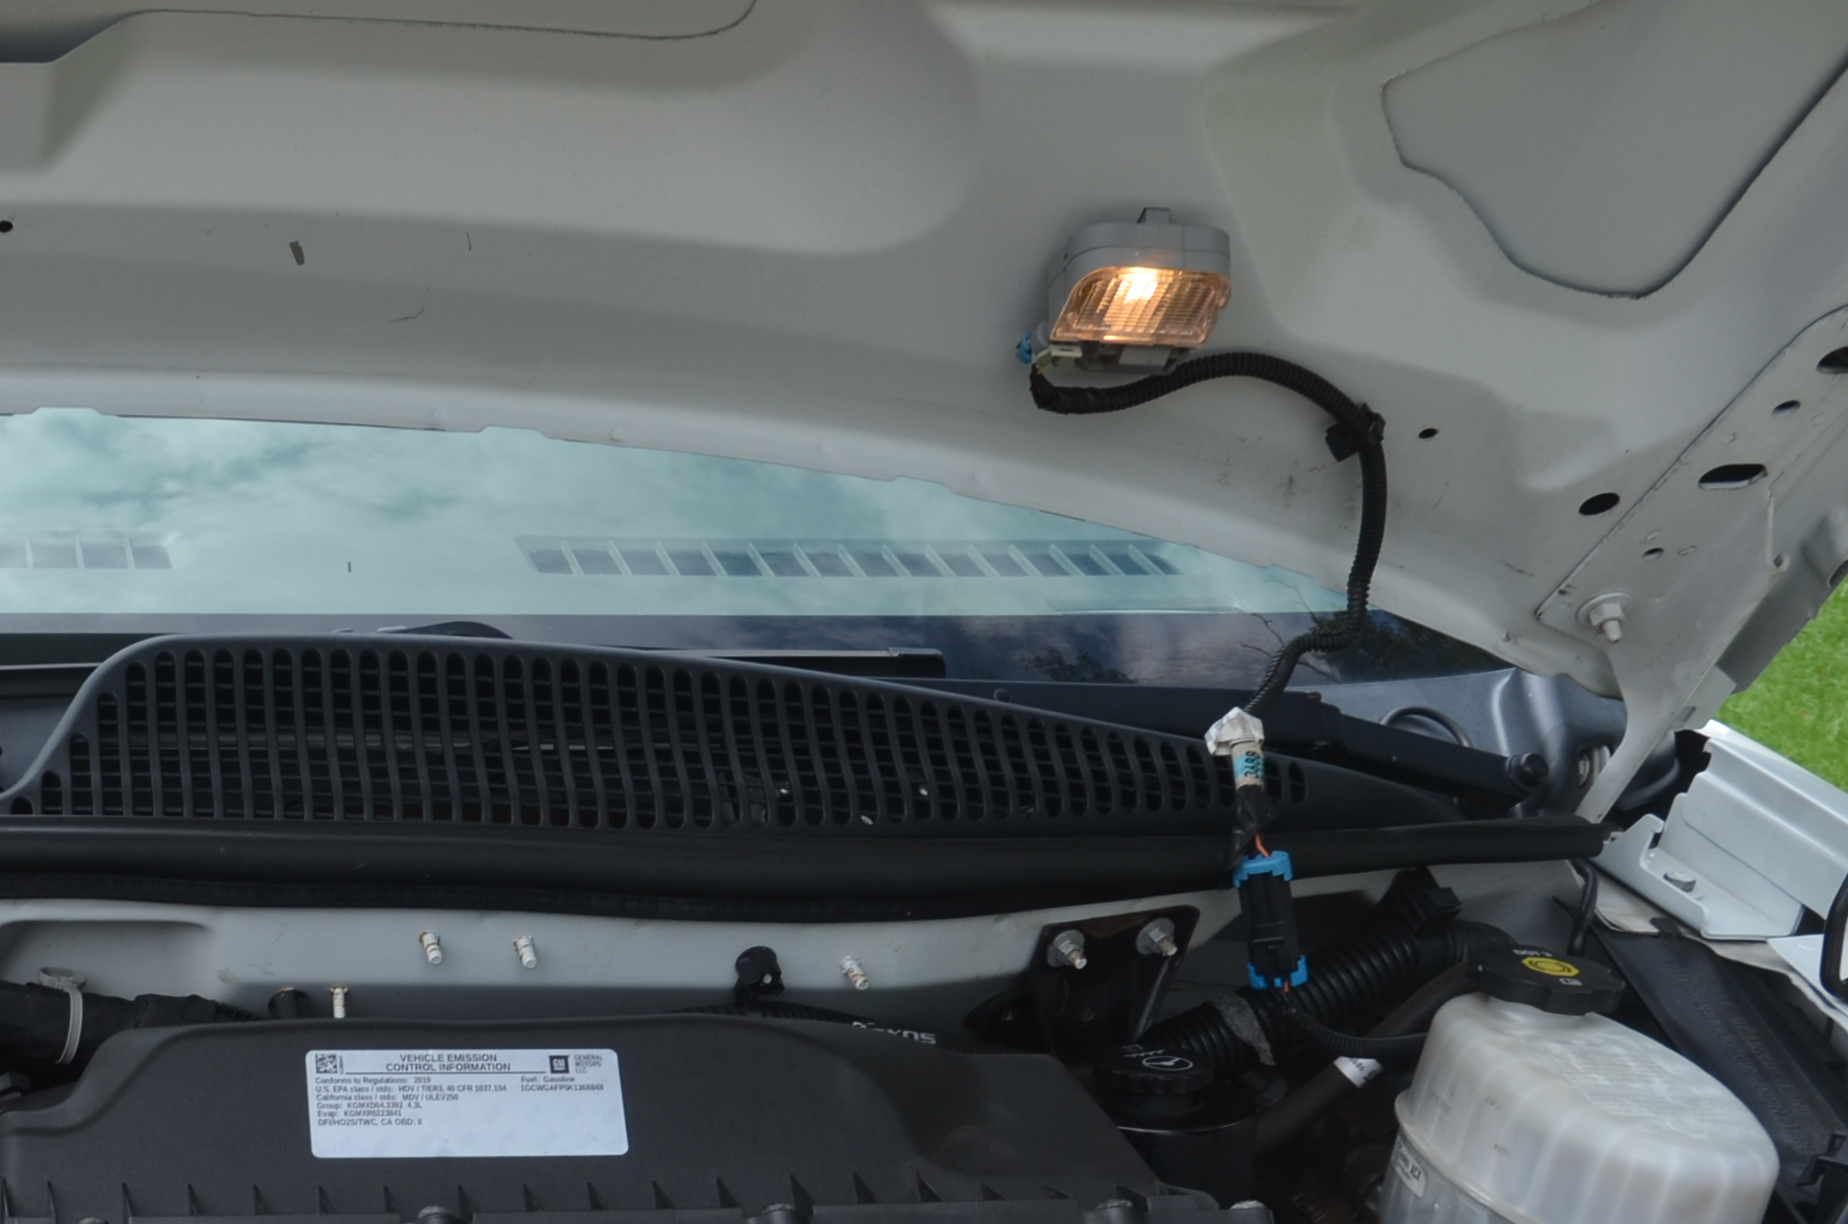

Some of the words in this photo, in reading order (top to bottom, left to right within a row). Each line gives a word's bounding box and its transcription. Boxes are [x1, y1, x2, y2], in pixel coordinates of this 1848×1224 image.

[400, 1053, 444, 1062] VEHICLE
[447, 1053, 497, 1062] EMISSION
[385, 1063, 437, 1071] CONTROL
[439, 1062, 511, 1071] INFORMATION
[315, 1076, 352, 1084] Conforms
[363, 1076, 409, 1086] Regulations:
[316, 1093, 352, 1101] California
[402, 1093, 419, 1101] MDV
[317, 1102, 343, 1110] Group:
